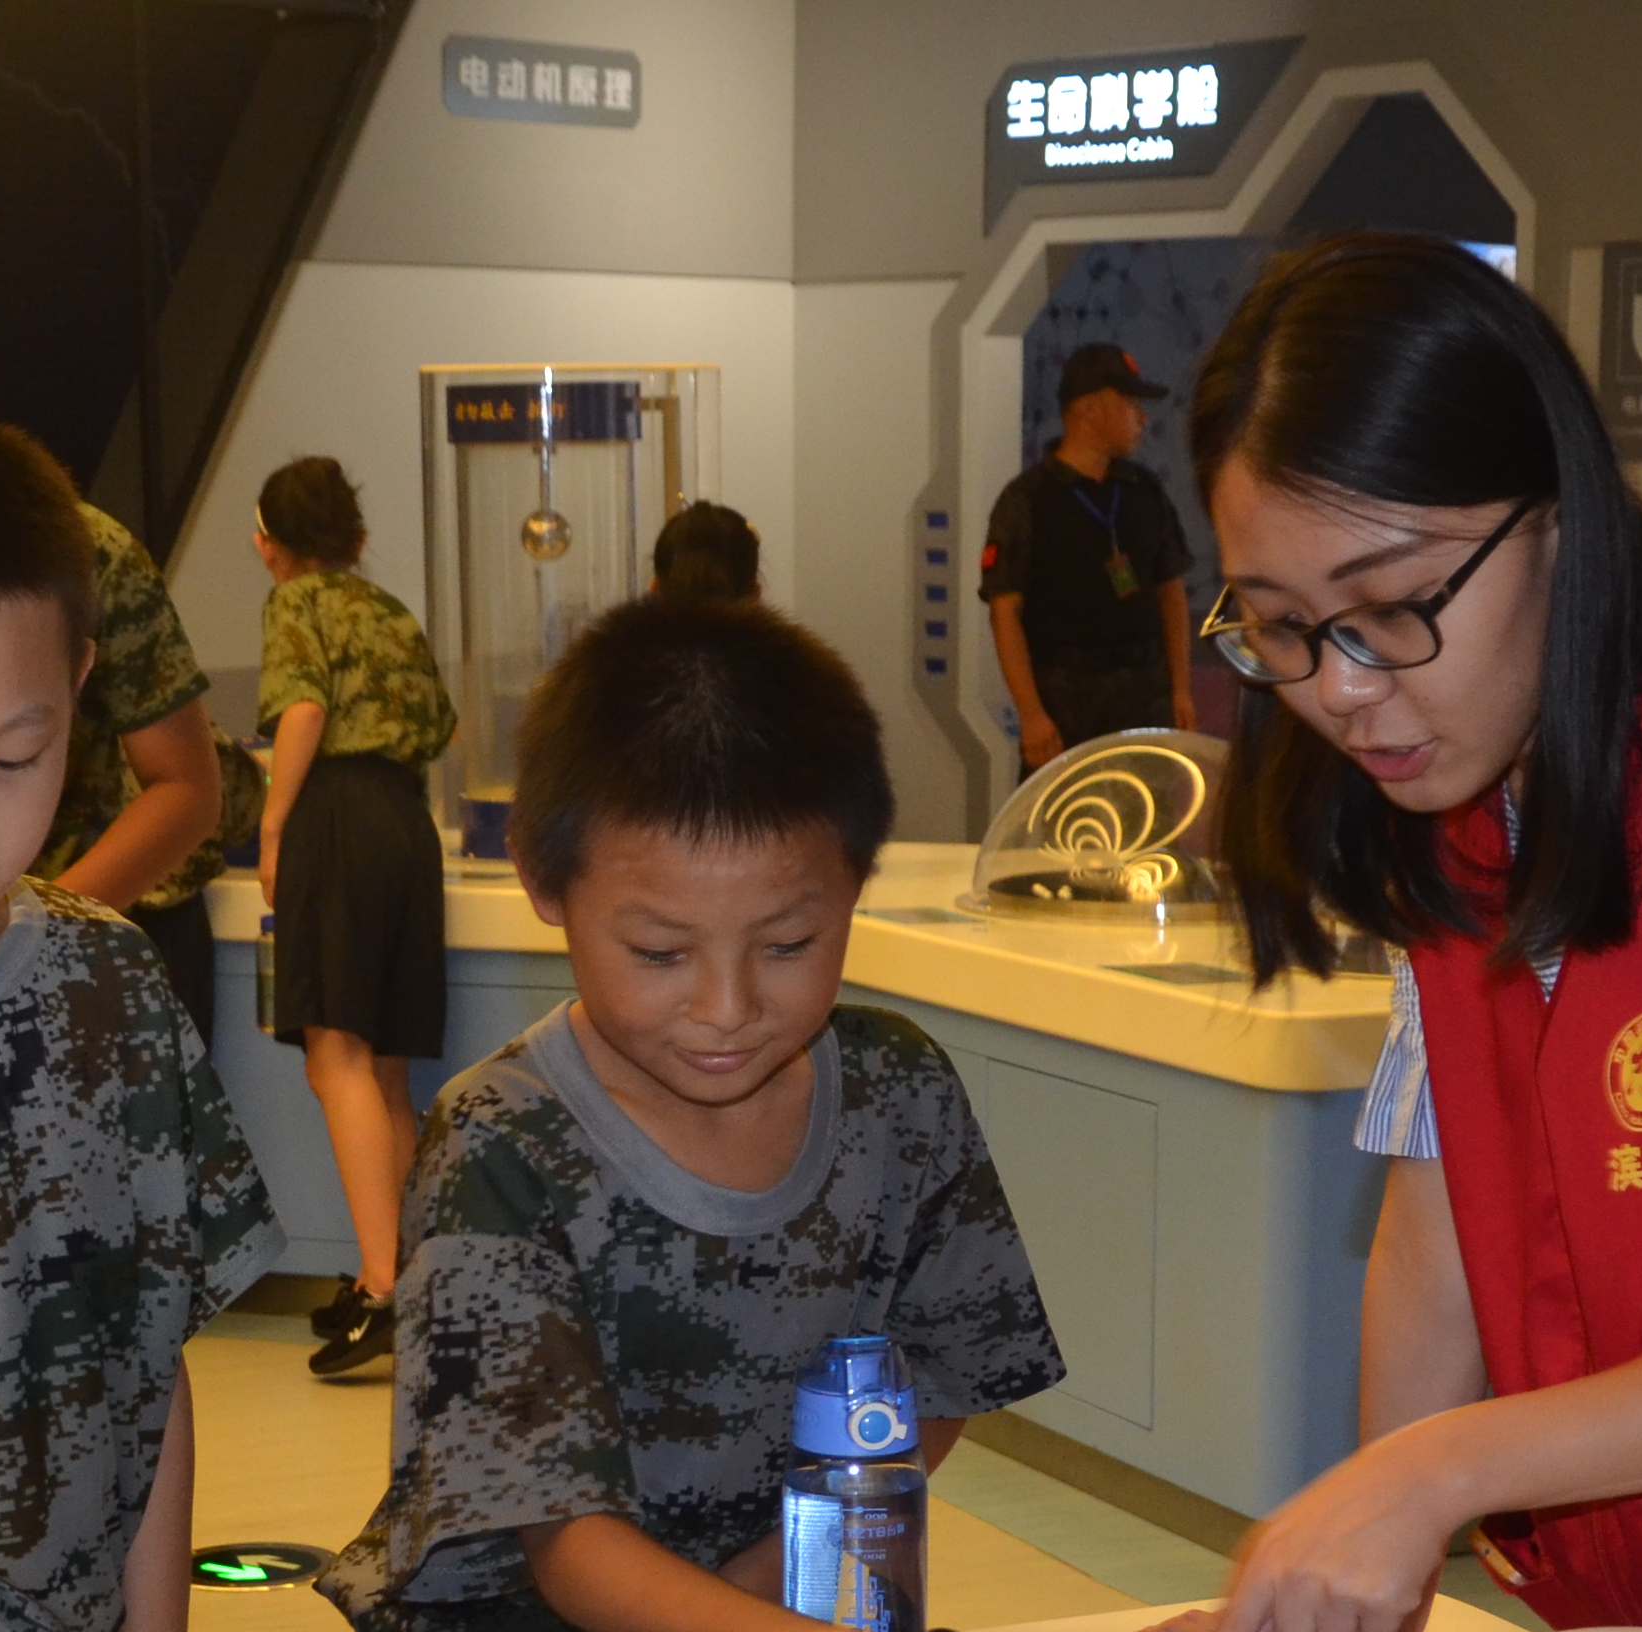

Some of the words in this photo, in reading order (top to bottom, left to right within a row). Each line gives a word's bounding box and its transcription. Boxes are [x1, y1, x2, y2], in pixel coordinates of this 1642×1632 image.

[459, 54, 632, 110] 电动机原理
[1007, 64, 1219, 138] 生命科学舱
[1126, 135, 1174, 162] Cabin
